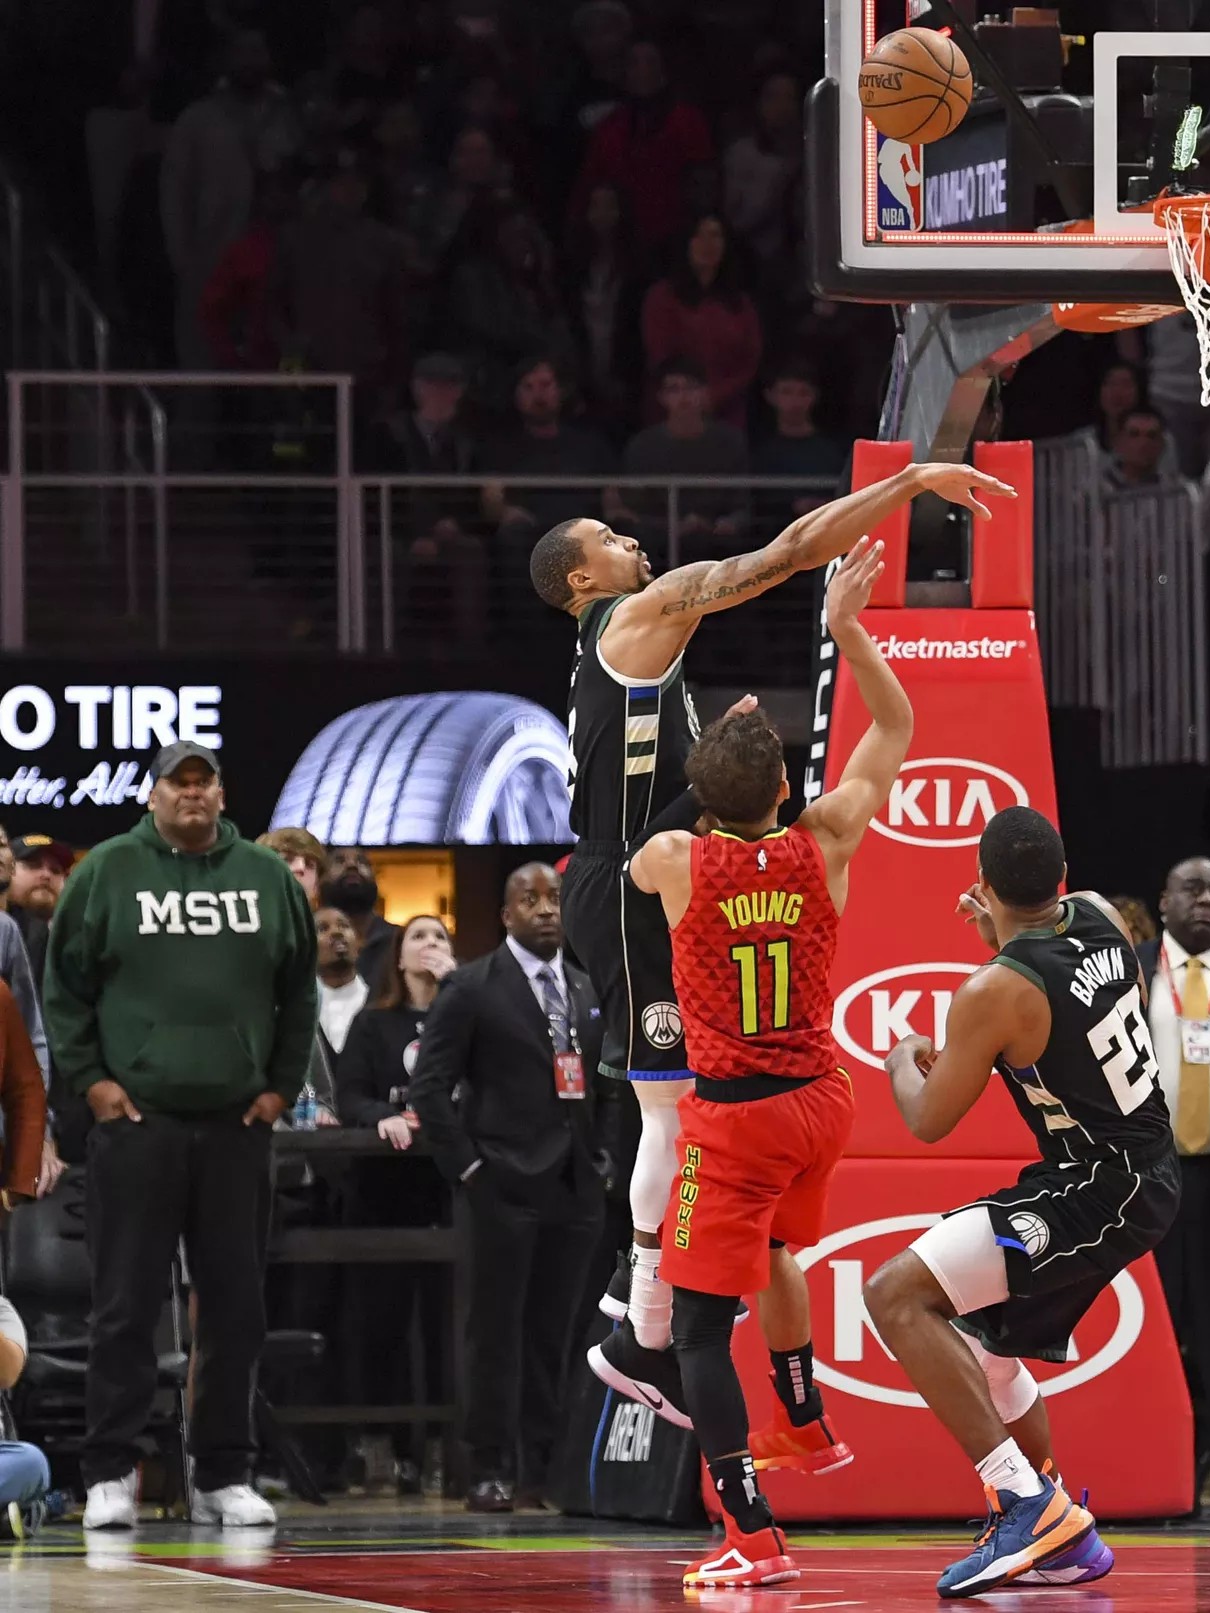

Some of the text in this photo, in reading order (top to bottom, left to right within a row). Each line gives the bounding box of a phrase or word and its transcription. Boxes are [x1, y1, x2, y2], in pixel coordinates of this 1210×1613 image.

[881, 208, 905, 226] NBA
[925, 158, 1007, 230] KUMHO TIRE
[870, 635, 1018, 660] icketmaster
[64, 685, 223, 750] TIRE
[888, 778, 997, 827] KIA
[135, 889, 261, 936] MSU
[718, 890, 804, 930] YOUNG
[730, 939, 791, 1037] 11
[1070, 947, 1125, 1007] BROWN
[868, 989, 953, 1052] KI
[1086, 983, 1160, 1116] 23
[675, 1144, 701, 1250] HAWKS
[603, 1402, 656, 1462] ARENA
